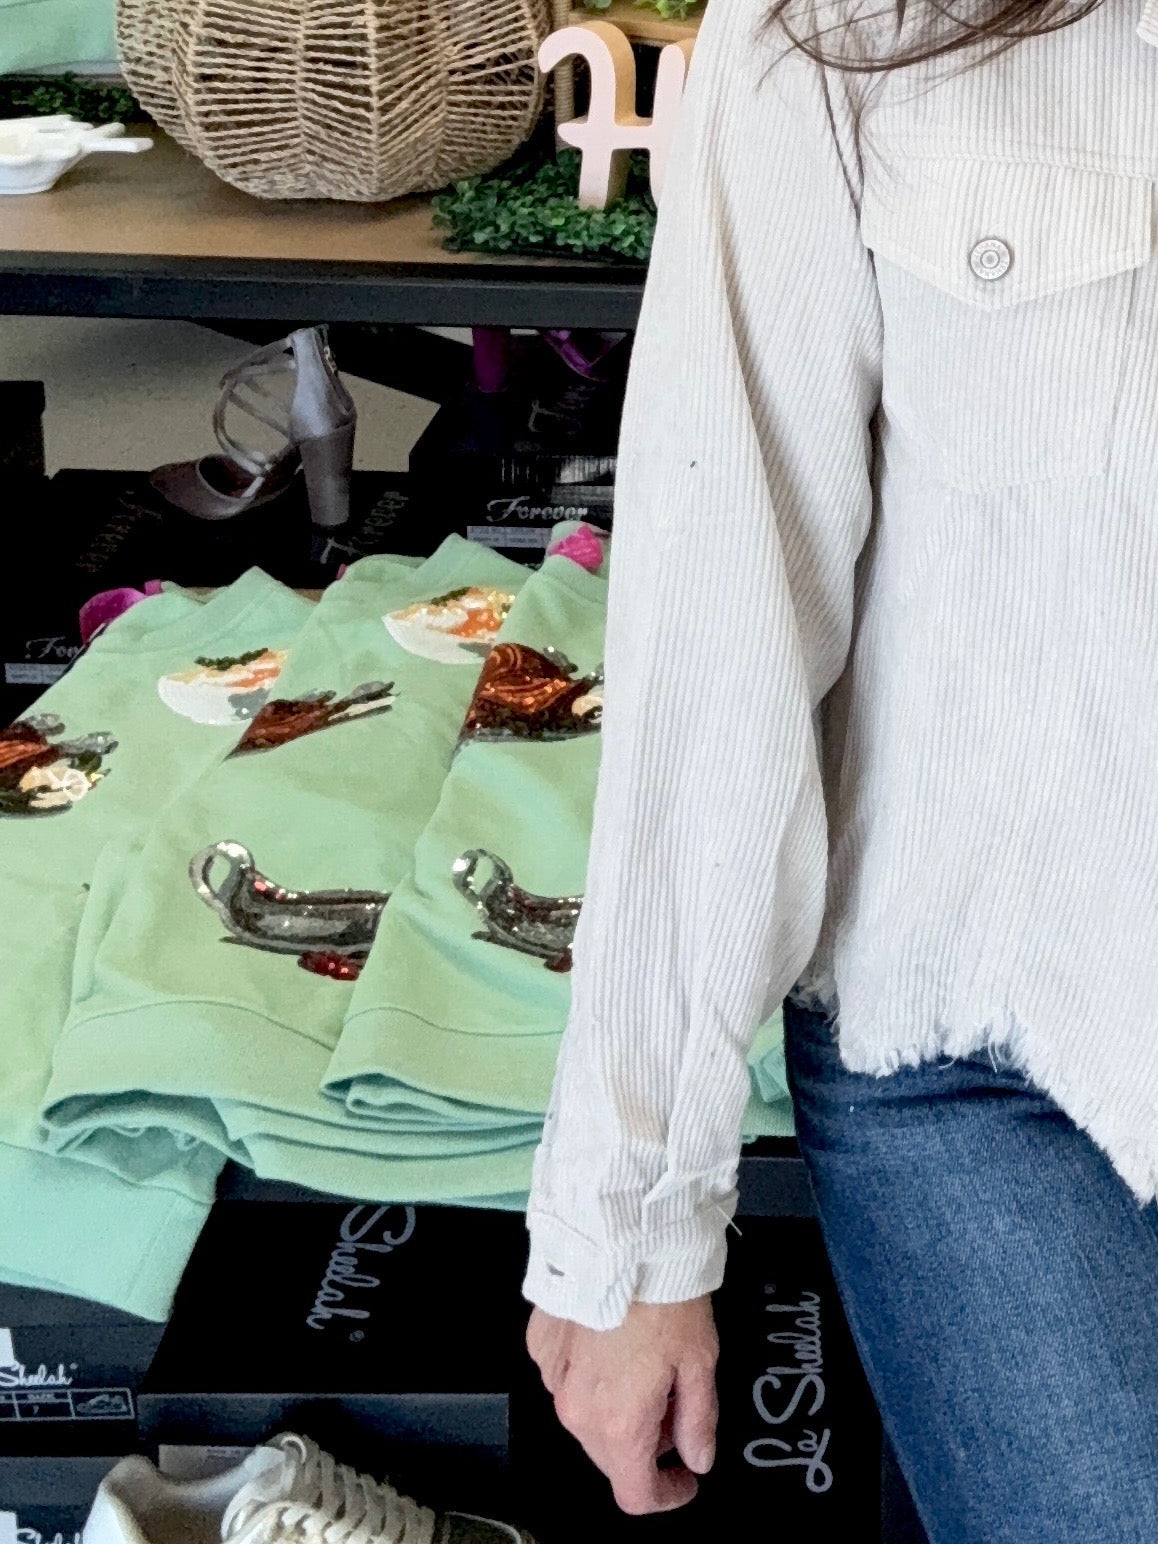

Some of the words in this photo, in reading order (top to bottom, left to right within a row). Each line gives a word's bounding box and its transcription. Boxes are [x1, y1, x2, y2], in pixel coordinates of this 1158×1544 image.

[486, 495, 588, 523] Forever
[753, 1291, 826, 1424] Sheelah
[743, 1428, 833, 1493] La
